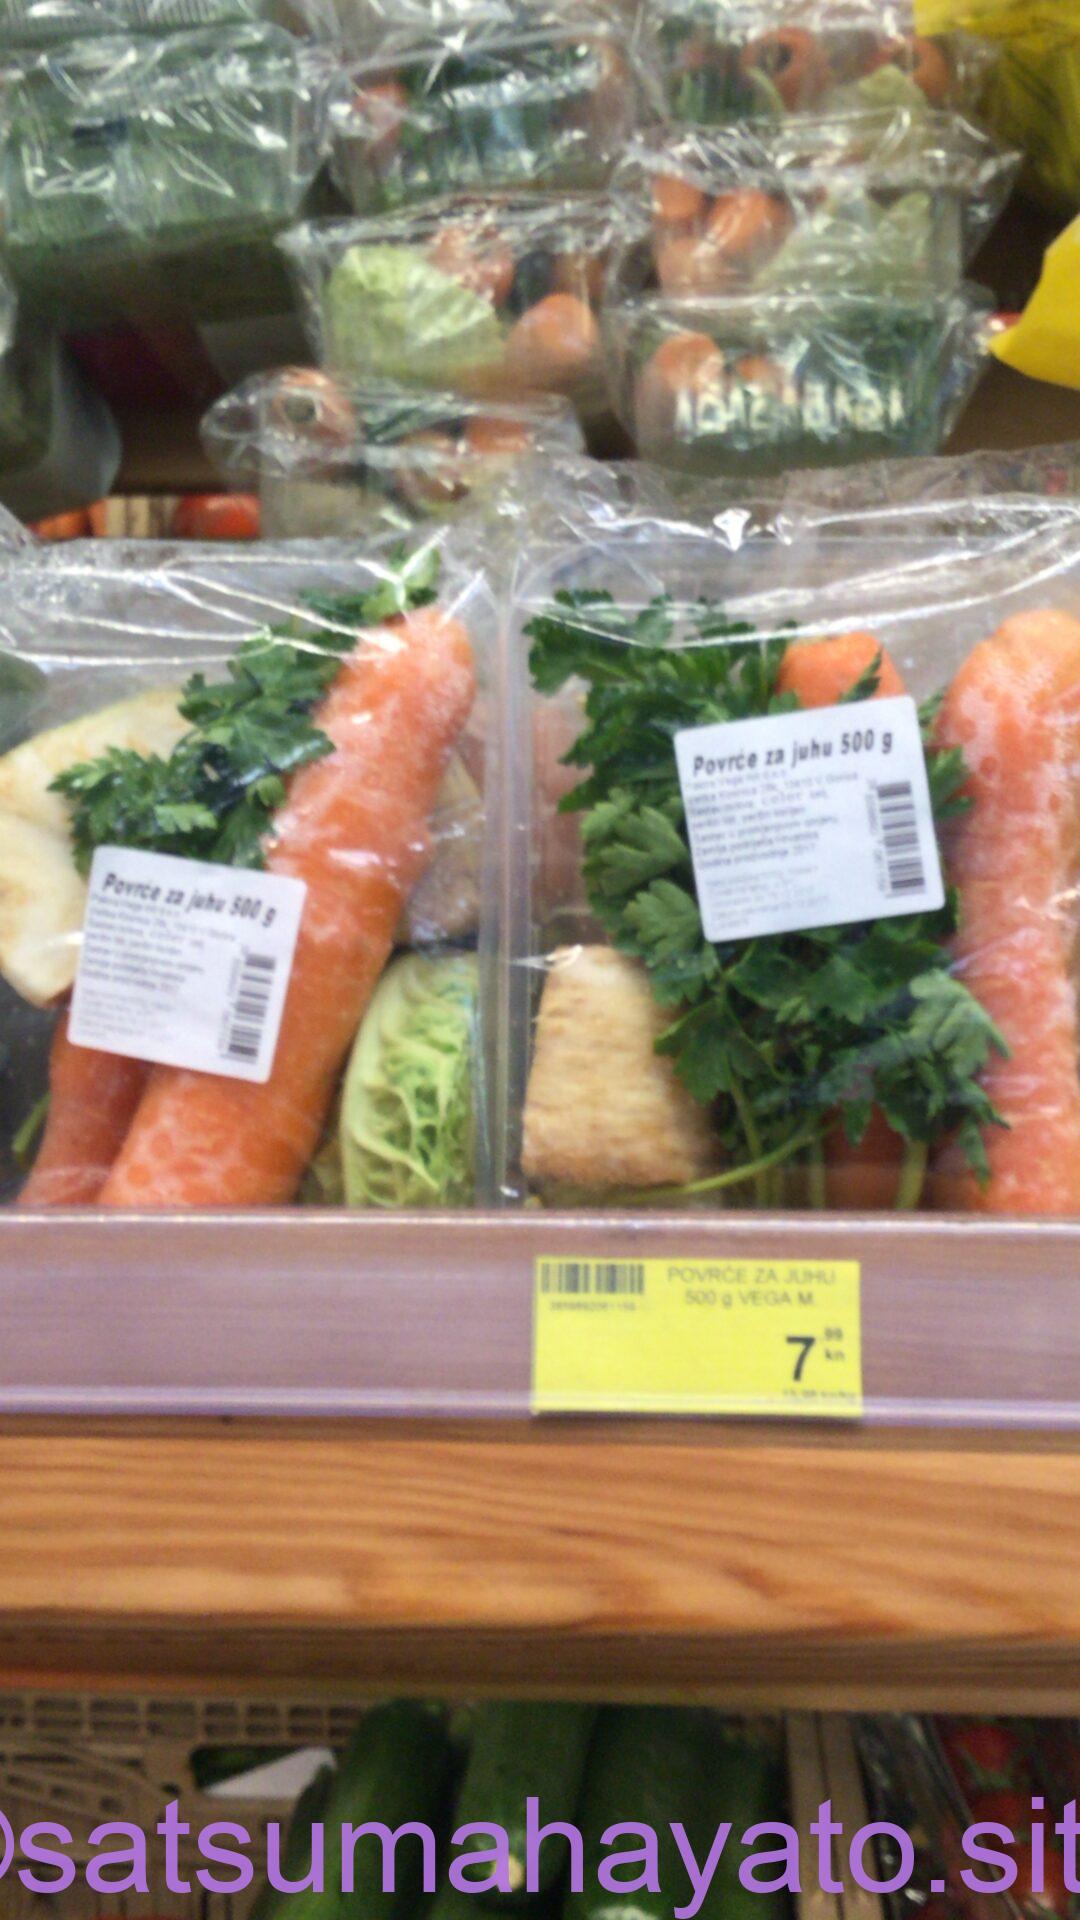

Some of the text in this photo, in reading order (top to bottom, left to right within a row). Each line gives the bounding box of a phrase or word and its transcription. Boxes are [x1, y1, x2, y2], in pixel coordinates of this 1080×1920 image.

[765, 748, 785, 766] za
[791, 740, 833, 768] juhu
[840, 729, 875, 755] 500
[882, 731, 893, 754] g
[165, 890, 185, 905] za
[187, 888, 226, 914] juhu
[230, 895, 262, 919] 500
[262, 907, 276, 928] g
[754, 1267, 779, 1284] ZA
[784, 1268, 836, 1285] JUHU
[685, 1290, 717, 1305] 500
[723, 1292, 732, 1308] g
[738, 1290, 792, 1305] VEGA
[786, 1336, 815, 1381] 7
[825, 1348, 845, 1360] kn
